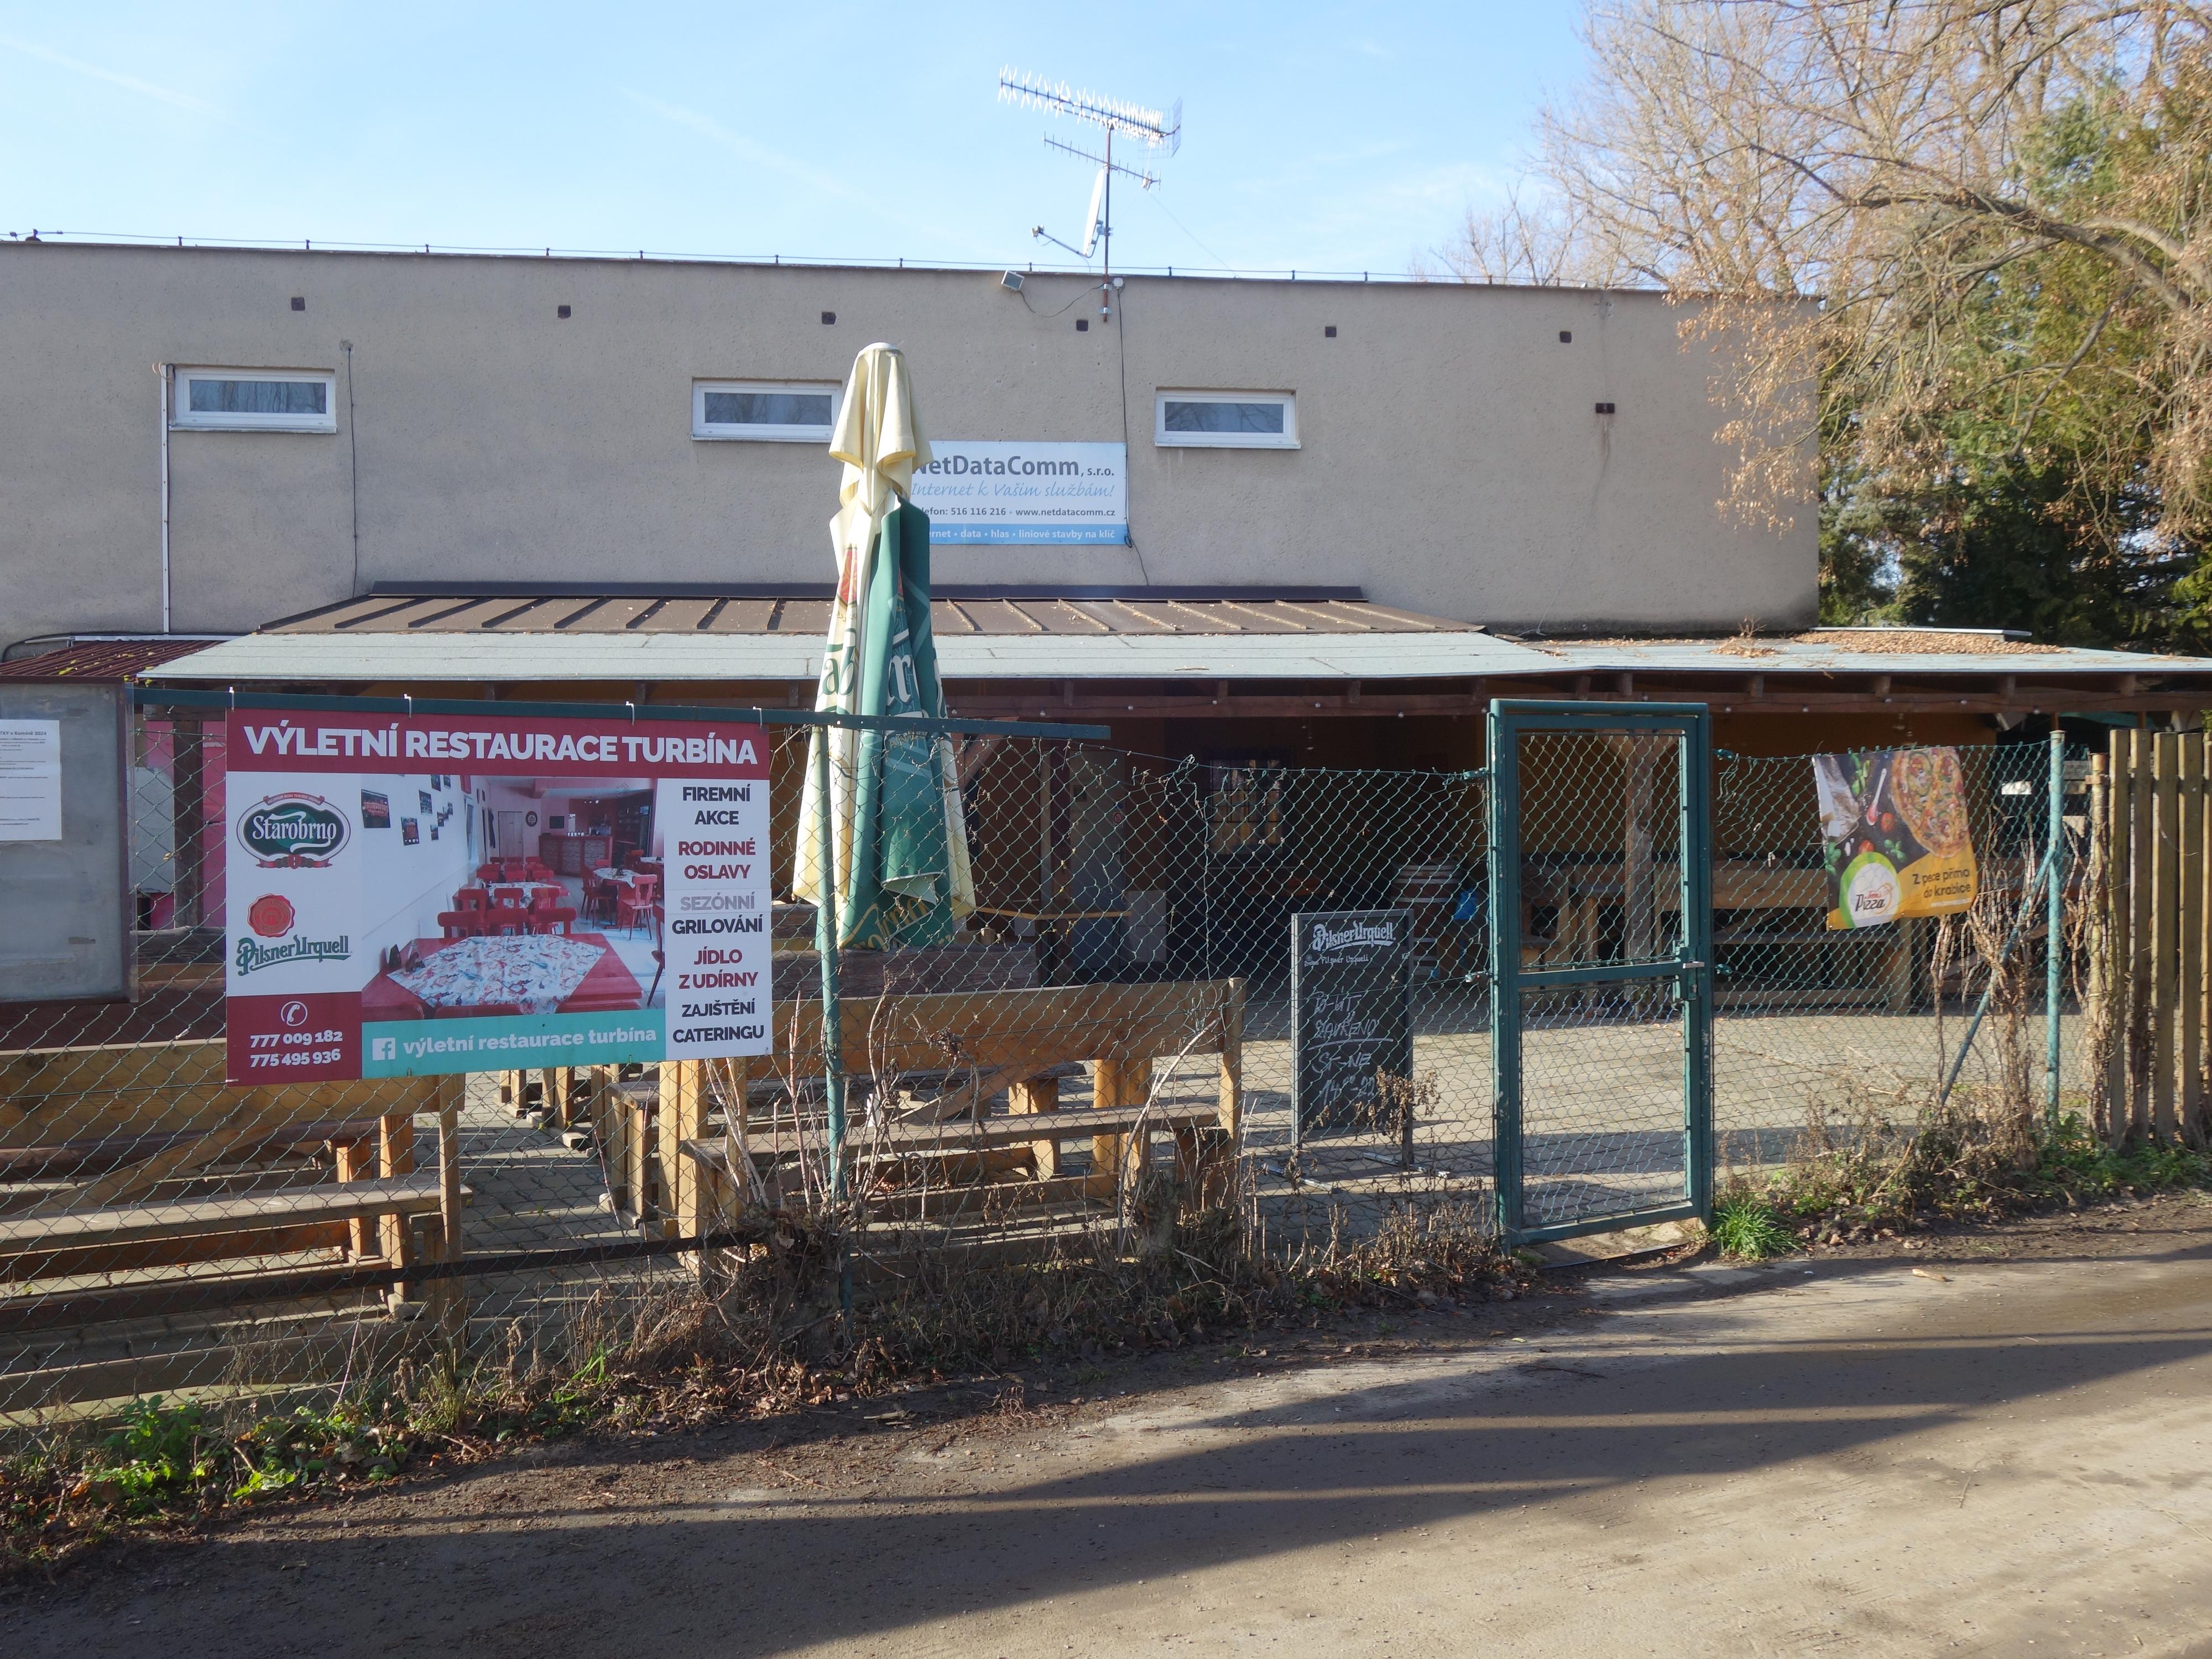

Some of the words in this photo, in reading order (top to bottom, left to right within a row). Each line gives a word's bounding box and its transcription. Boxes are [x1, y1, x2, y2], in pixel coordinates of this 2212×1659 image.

[1087, 467, 1114, 476] s.r.o.
[911, 482, 974, 495] Internet
[978, 480, 989, 495] k
[995, 482, 1041, 496] Vašim
[1045, 481, 1114, 497] službám!
[1016, 508, 1115, 516] www.netdatacomm.cz
[961, 529, 981, 538] data
[991, 529, 1009, 538] hlas
[1019, 529, 1050, 538] liniové
[1052, 529, 1082, 540] stavby
[1099, 529, 1115, 538] klíč
[243, 720, 399, 757] VÝLETNÍ
[405, 730, 618, 761] RESTAURACE
[622, 732, 758, 764] TURBÍNA
[682, 784, 750, 801] FIREMNÍ
[695, 811, 739, 825] AKCE
[252, 811, 337, 853] Starobrno
[679, 837, 755, 855] RODINNÉ
[684, 864, 751, 879] OSLAVY
[680, 891, 755, 910] SEZÓNNÍ
[1855, 894, 1885, 912] Pizza
[672, 914, 763, 934] GRILOVÁNÍ
[1312, 923, 1354, 951] Pilsner
[1353, 920, 1393, 948] Urquell
[236, 937, 295, 976] Pilsner
[293, 935, 349, 963] Urquell
[694, 946, 742, 964] JÍDLO
[679, 974, 690, 989] Z
[693, 969, 759, 988] UDÍRNY
[682, 998, 755, 1017] ZAJIŠTĚNÍ
[251, 1034, 280, 1048] 777
[283, 1033, 312, 1045] 009
[315, 1030, 343, 1042] 182
[403, 1035, 474, 1058] výletní
[478, 1033, 583, 1050] restaurace
[588, 1027, 657, 1044] turbína
[673, 1025, 764, 1043] CATERINGU
[251, 1053, 279, 1067] 775
[281, 1052, 310, 1066] 495
[312, 1048, 341, 1064] 936
